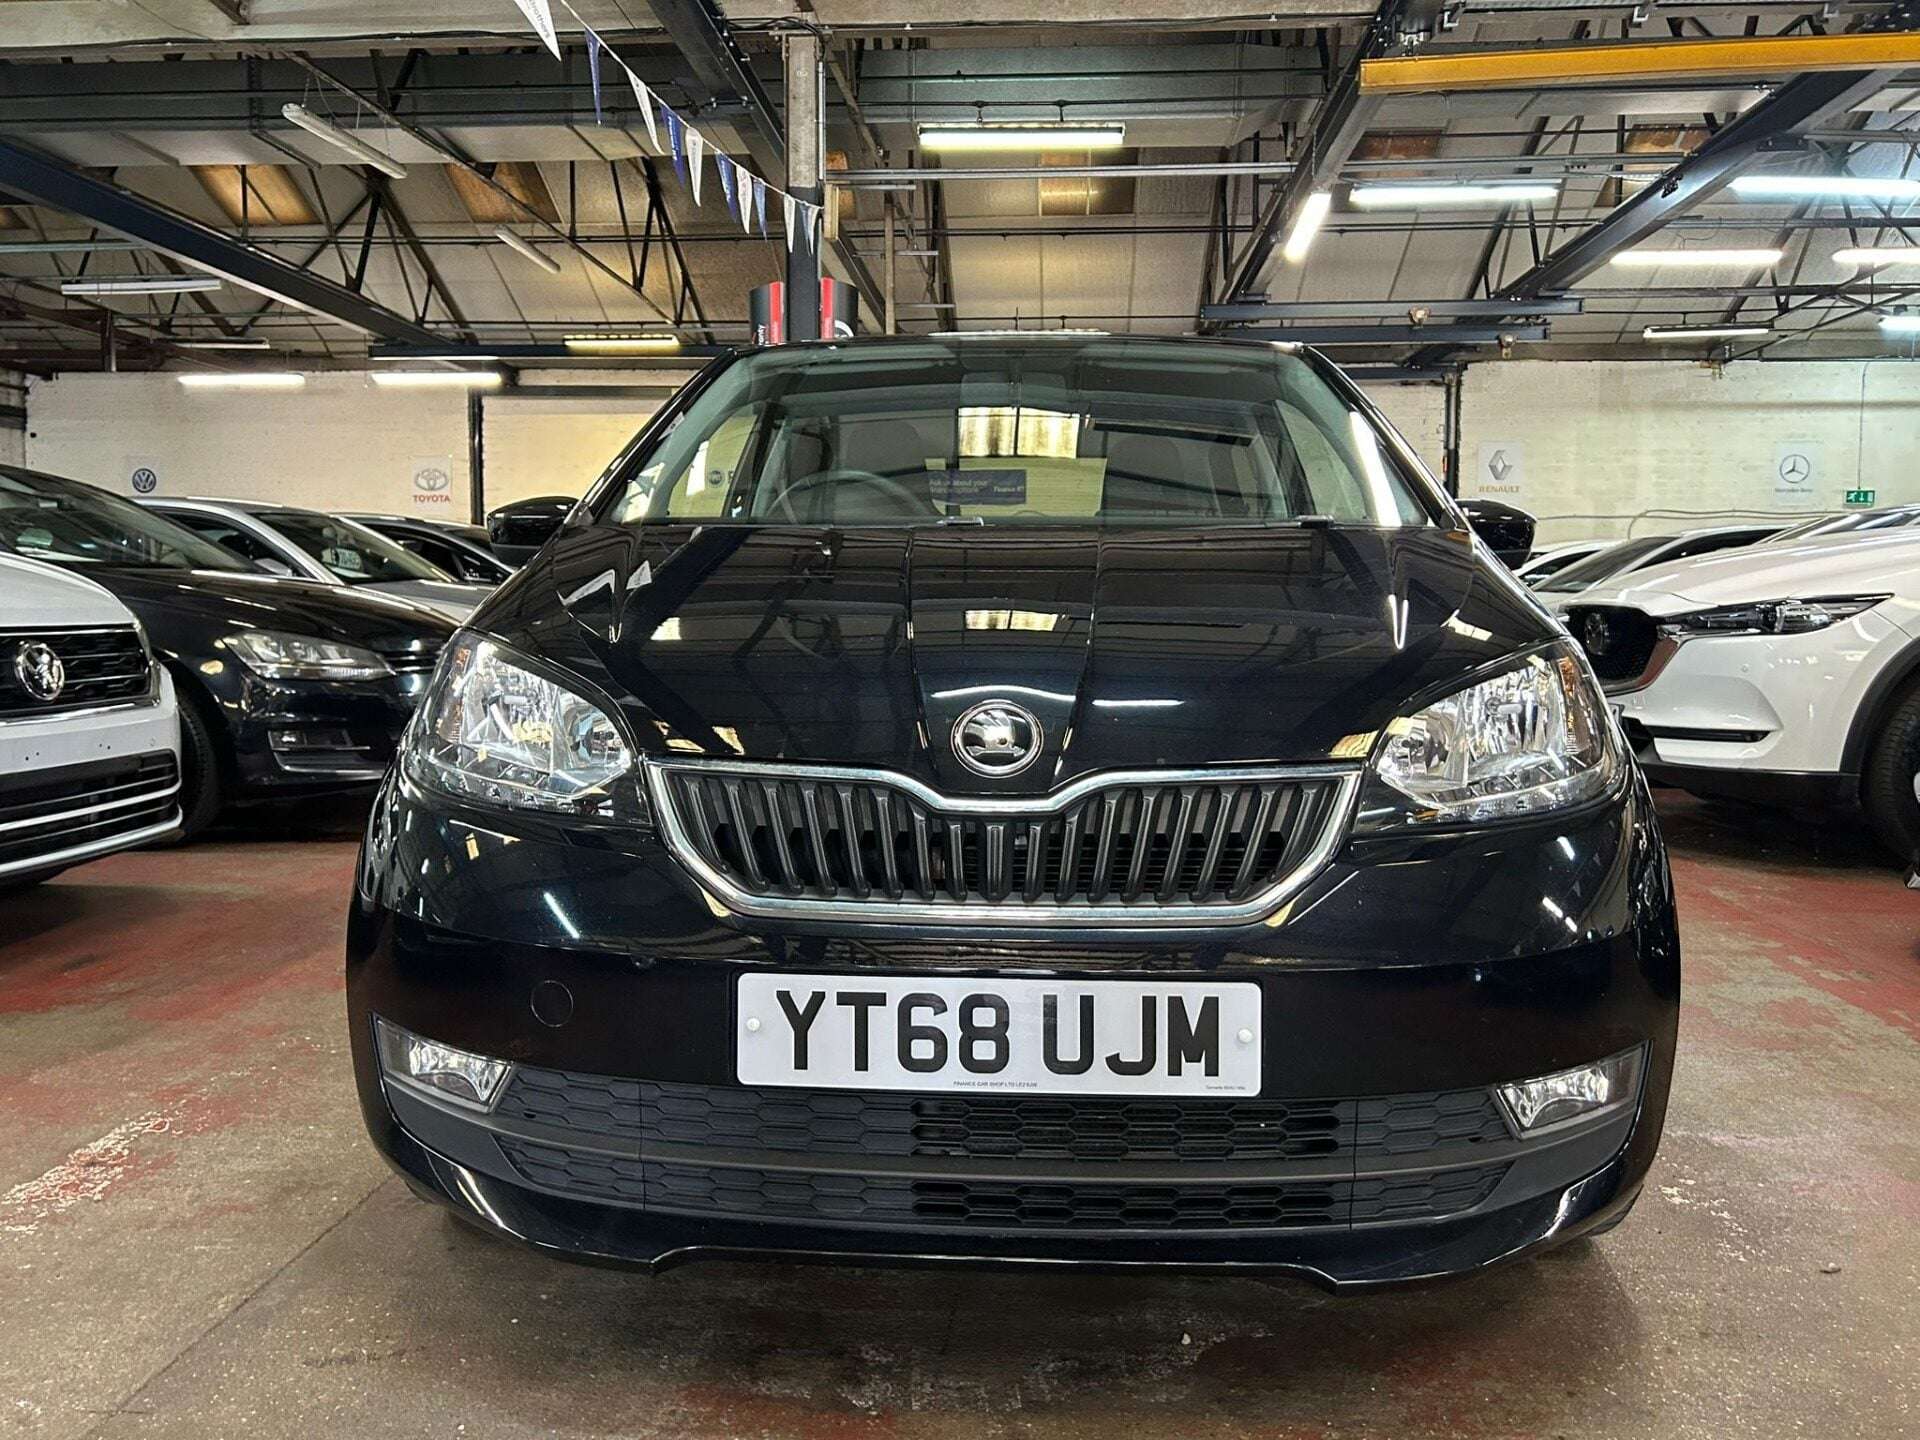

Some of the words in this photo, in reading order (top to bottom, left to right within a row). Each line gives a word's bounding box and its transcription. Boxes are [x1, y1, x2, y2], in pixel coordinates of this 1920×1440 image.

[413, 494, 450, 503] TOYOTA
[776, 990, 1010, 1075] YT68
[1042, 994, 1219, 1077] UJM
